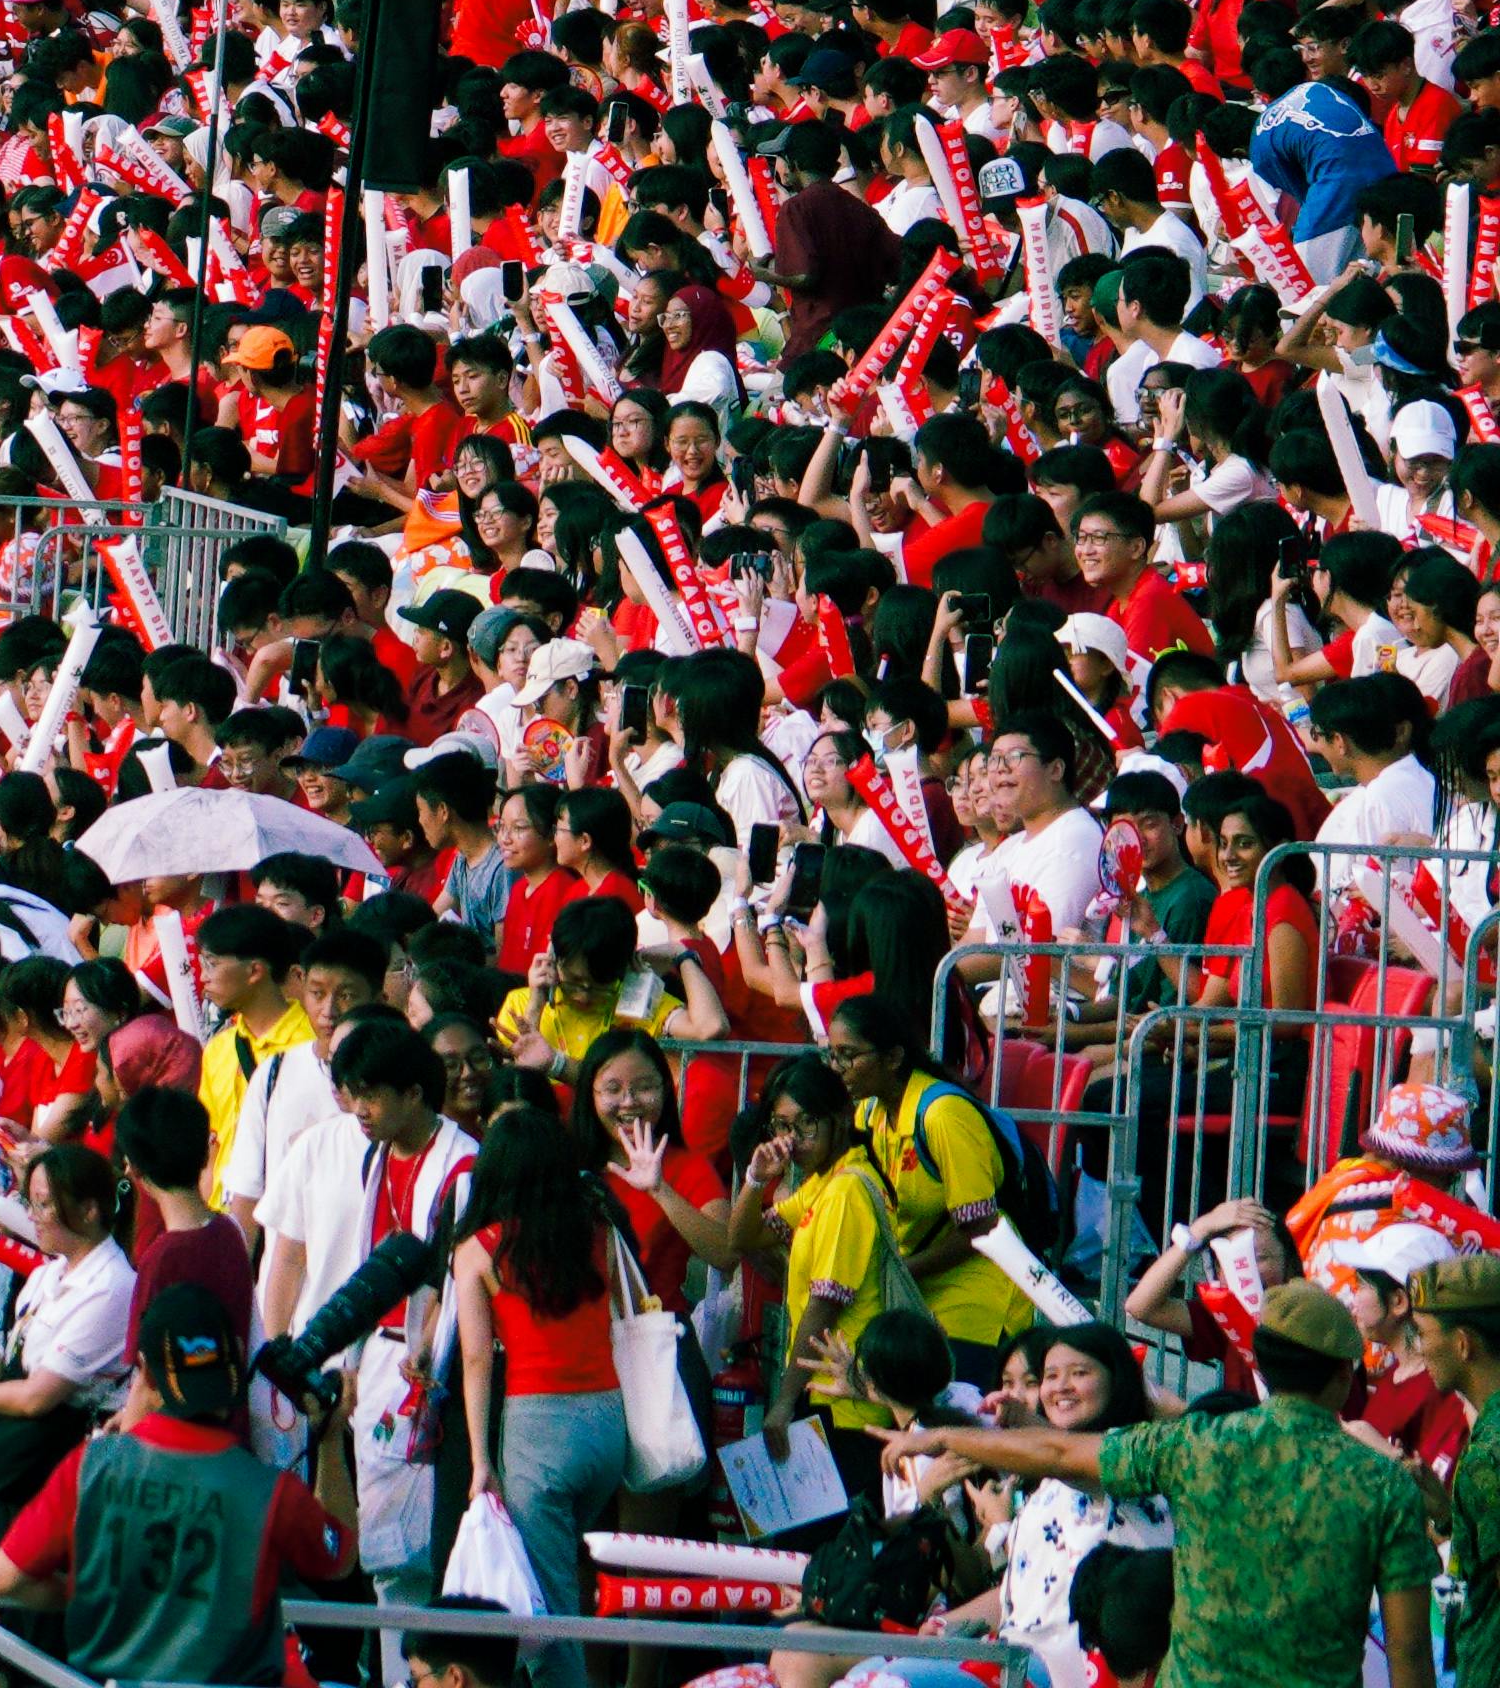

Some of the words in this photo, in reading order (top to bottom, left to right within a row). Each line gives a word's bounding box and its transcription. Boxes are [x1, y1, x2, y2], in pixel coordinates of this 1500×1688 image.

[947, 138, 991, 272] SINGAPORE
[1028, 222, 1047, 277] HAPPY
[1247, 246, 1295, 288] HAPPY
[850, 263, 951, 399] SINGAPORE
[125, 554, 156, 608] HAPPY
[105, 1473, 224, 1516] MEDIA
[106, 1515, 219, 1600] 132
